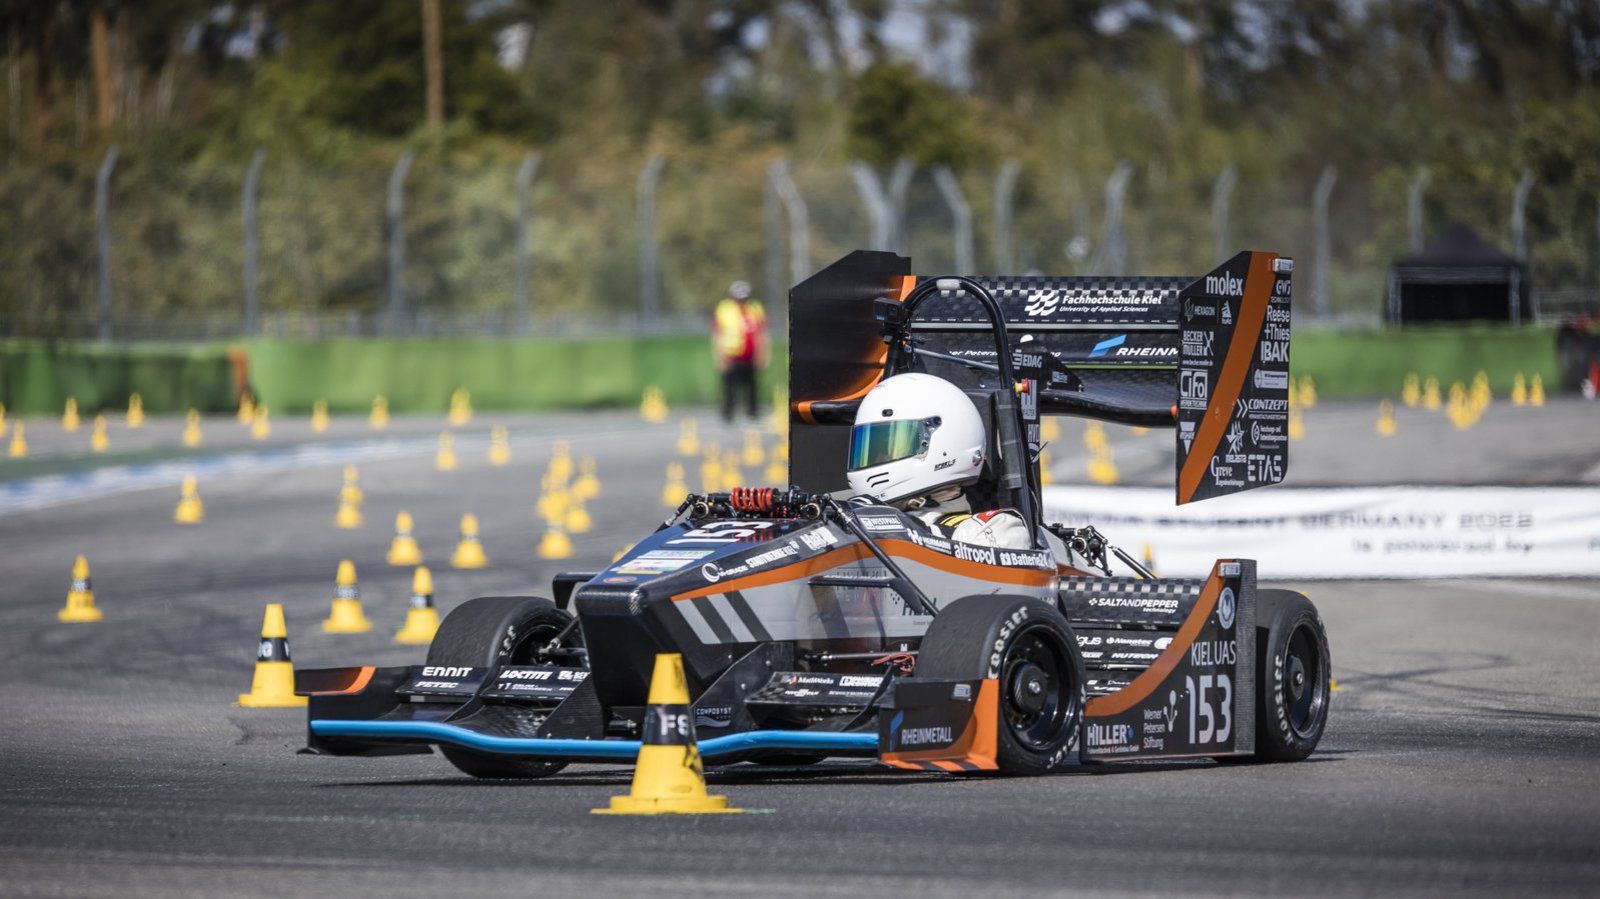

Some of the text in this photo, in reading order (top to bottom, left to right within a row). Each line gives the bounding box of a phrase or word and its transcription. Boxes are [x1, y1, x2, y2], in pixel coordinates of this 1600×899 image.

[1206, 271, 1243, 296] molex
[1063, 295, 1162, 304] Fachhochschule Kiel
[1194, 306, 1215, 316] HEXAGON
[1267, 305, 1290, 322] Reese
[1183, 330, 1203, 341] BECKER
[1261, 341, 1289, 362] IBAK
[1023, 355, 1042, 368] EDAG
[1249, 399, 1288, 411] CONTZEPT
[1247, 454, 1282, 482] ETAS
[954, 542, 996, 566] altropol
[1098, 599, 1178, 608] SALTANDPEPPER
[1191, 640, 1237, 666] KIEL UAS
[422, 667, 473, 677] ENNIT
[500, 670, 553, 680] LOCTITE
[405, 681, 459, 689] PETEC
[1186, 674, 1232, 744] 153
[902, 727, 952, 744] RHEINMETALL
